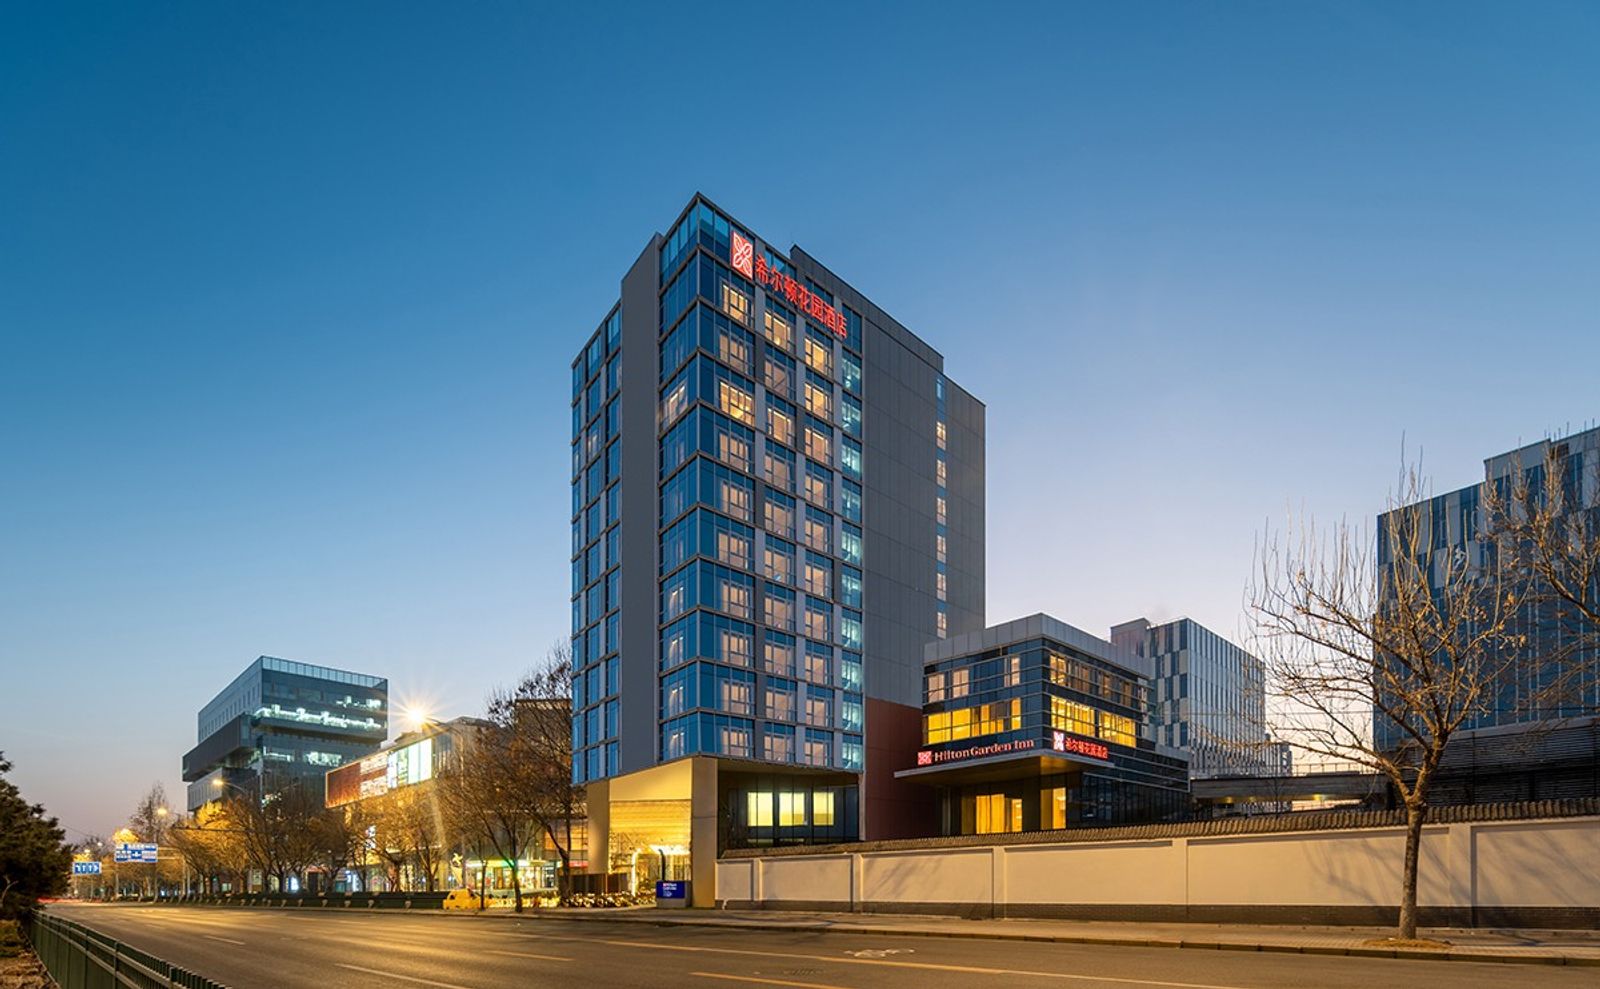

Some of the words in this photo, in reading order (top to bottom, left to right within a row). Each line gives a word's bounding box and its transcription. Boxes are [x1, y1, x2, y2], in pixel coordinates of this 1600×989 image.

[755, 253, 847, 338] 希尔顿花园酒店
[934, 749, 970, 762] Hilton
[970, 742, 1012, 756] Garden
[1014, 739, 1034, 750] Inn
